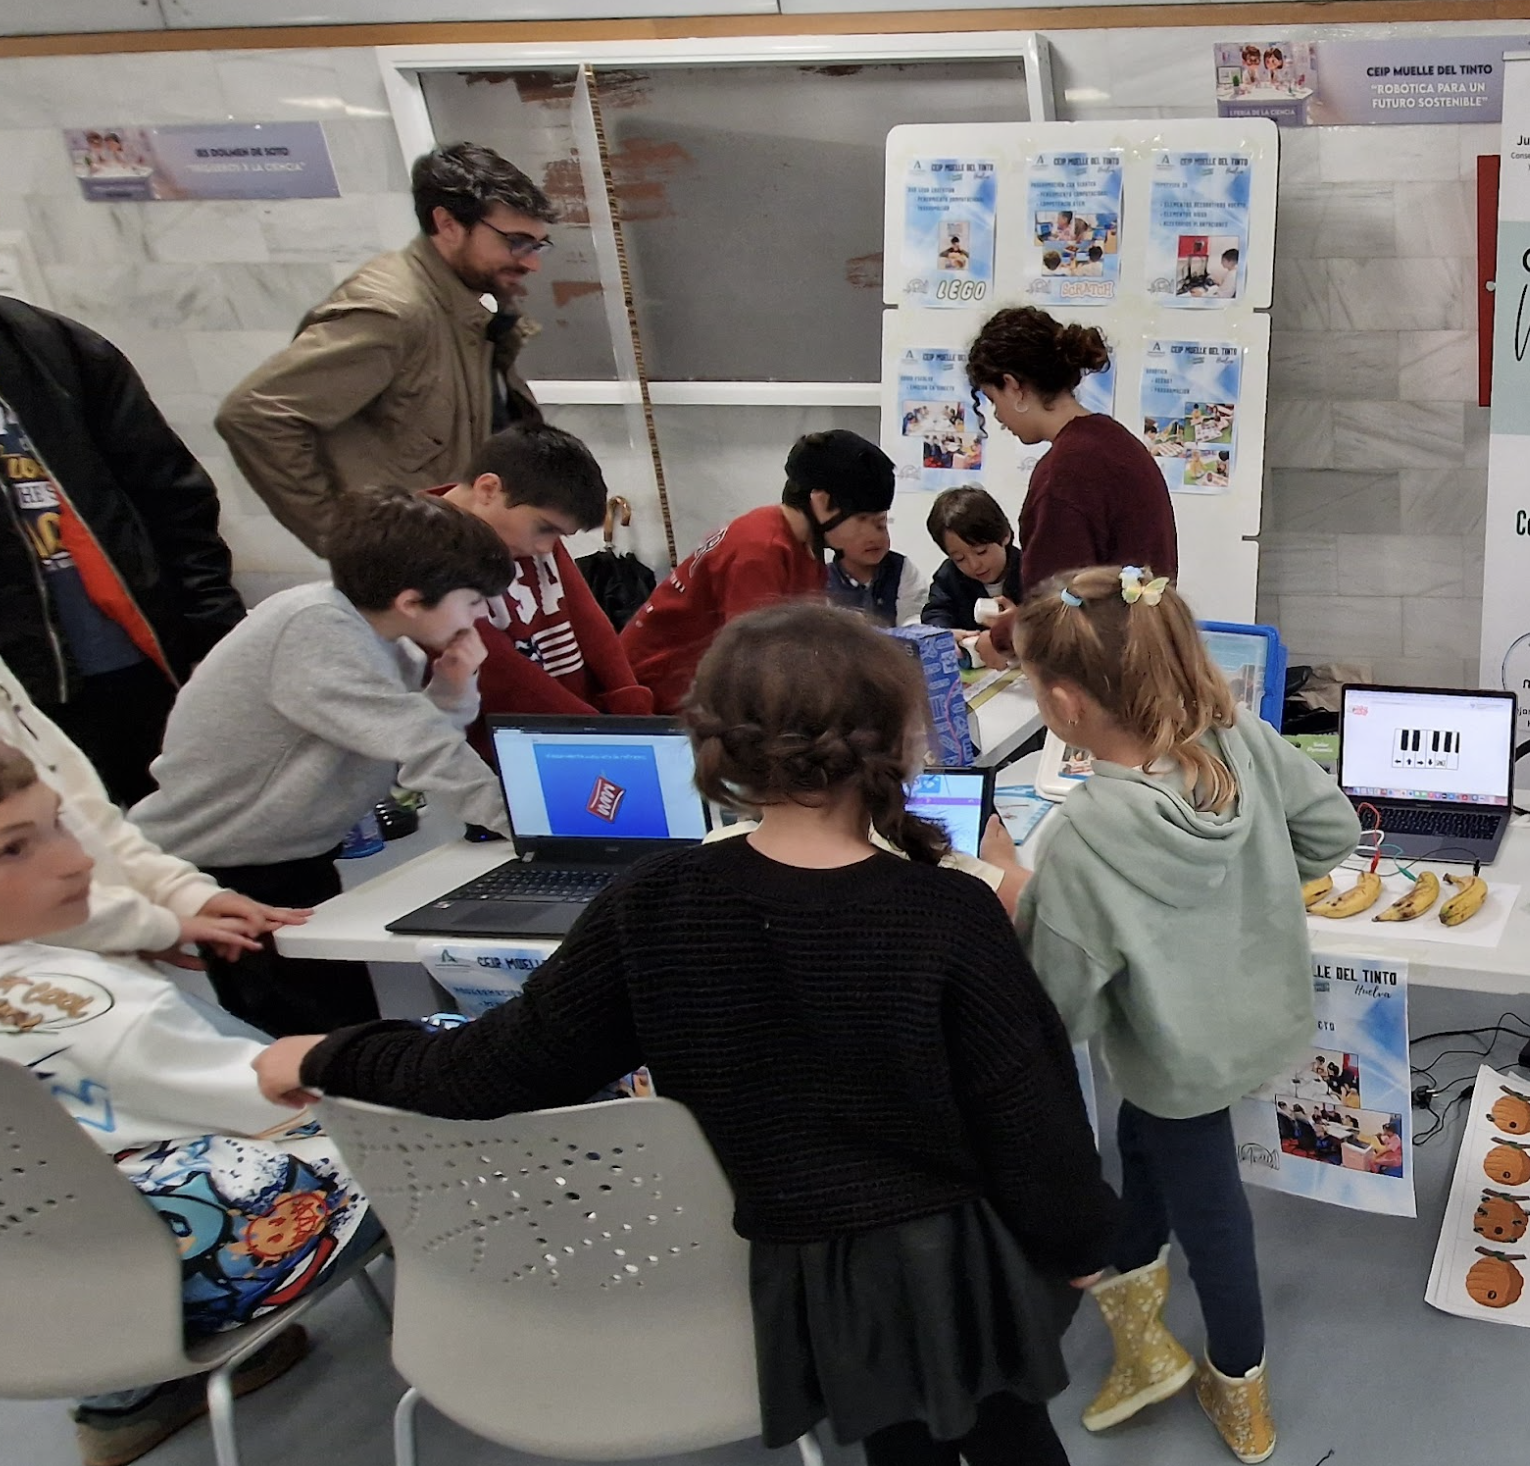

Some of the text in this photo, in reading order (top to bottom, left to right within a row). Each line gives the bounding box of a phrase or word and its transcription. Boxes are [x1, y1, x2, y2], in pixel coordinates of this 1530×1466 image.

[1367, 64, 1493, 77] CEIP MUELLE DEL TINTO
[1437, 83, 1466, 93] PARA
[1469, 82, 1485, 92] UN
[1372, 98, 1415, 109] FUTURO
[936, 279, 987, 301] LEGO
[1061, 281, 1114, 297] SCRATCH
[476, 956, 501, 967] CEIP
[1336, 966, 1358, 982] DEL
[1362, 969, 1397, 986] TINTO
[1354, 984, 1392, 999] Huelva
